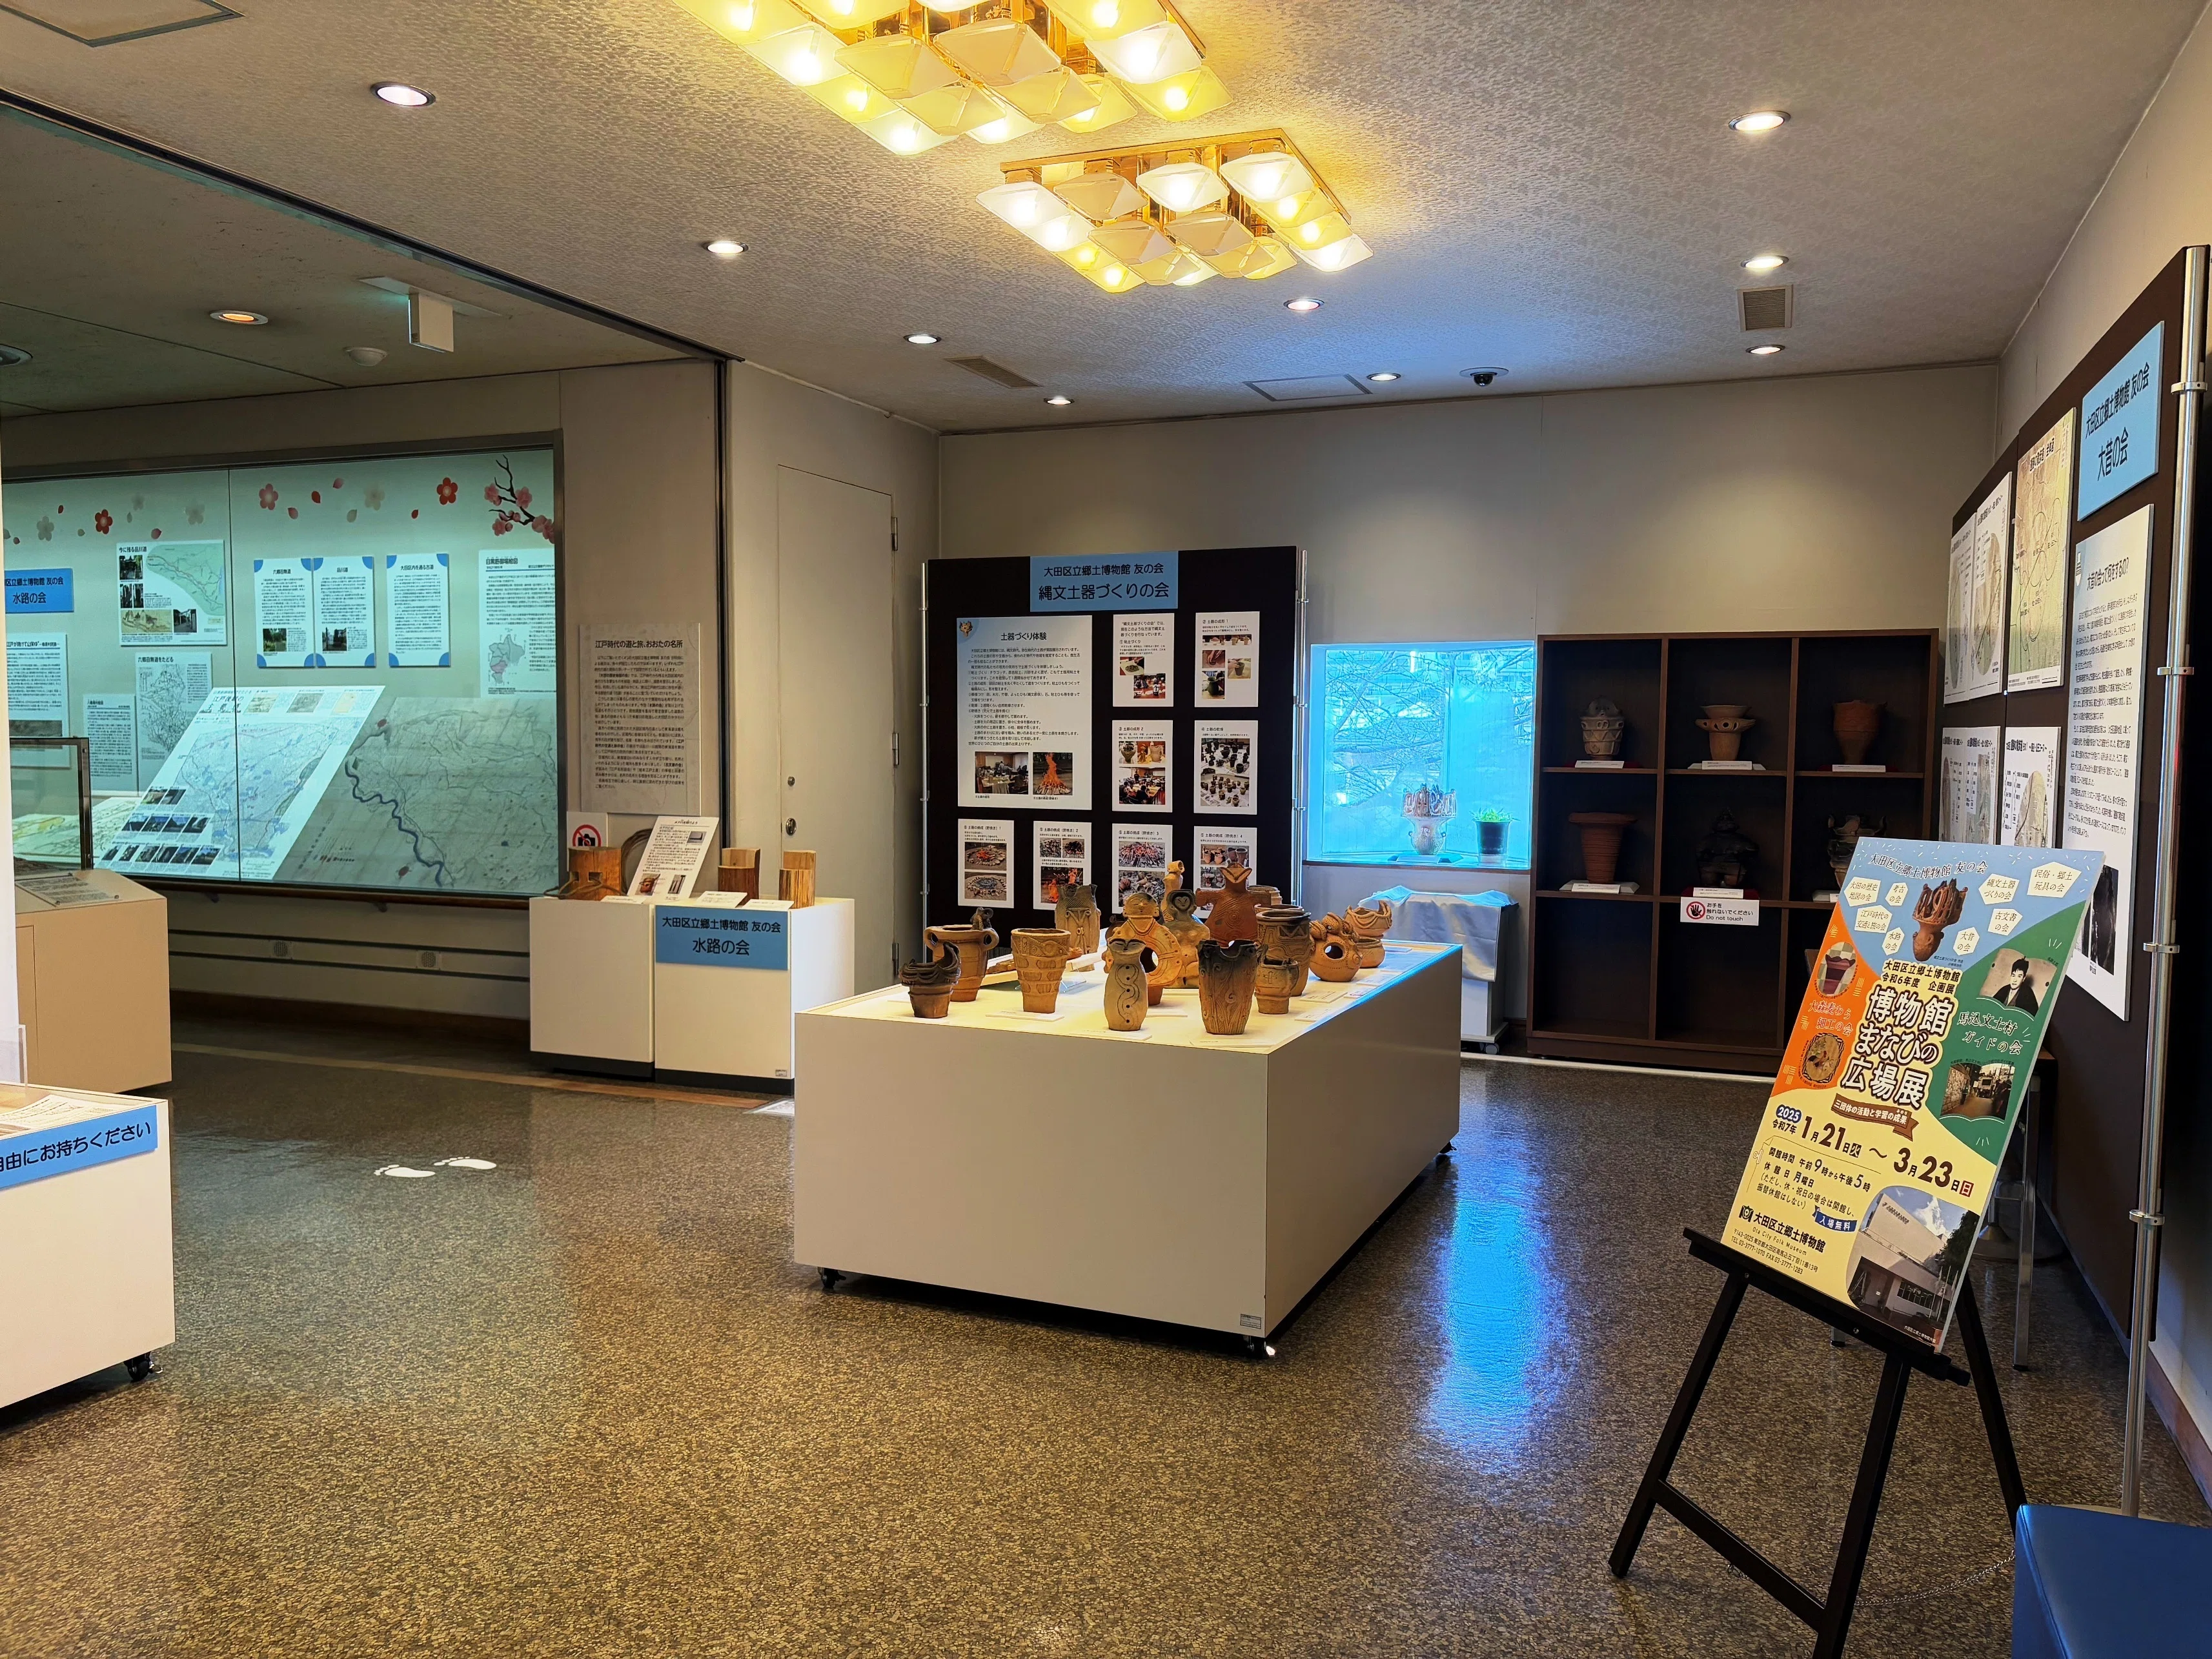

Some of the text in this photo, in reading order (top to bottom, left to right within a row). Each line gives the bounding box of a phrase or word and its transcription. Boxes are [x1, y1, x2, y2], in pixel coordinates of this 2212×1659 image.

[2085, 361, 2150, 439] 大田区立郷土博物館 友の会
[2098, 427, 2128, 481] 大昔の会
[1044, 562, 1164, 577] 大田区立郷土博物館 友の会
[5, 576, 64, 586] 区立郷土博物館 友の会
[13, 591, 46, 604] 水路の会
[1039, 582, 1169, 601] 縄文土器づくりの会
[595, 640, 683, 648] 江戸時代の道と旅、おおたの名所
[1001, 632, 1047, 641] 土器づくり体験
[1870, 853, 1987, 879] 大田区立郷土博物館 友の会
[2034, 869, 2073, 881] 民俗・郷土
[1850, 880, 1878, 892] 大田の歴史
[1892, 884, 1905, 894] 考古
[1986, 879, 2017, 889] 縄文土器
[2034, 880, 2065, 893] 玩具の会
[1849, 891, 1872, 902] 地図の会
[1889, 894, 1902, 904] の会
[1984, 889, 2012, 901] づくりの会
[1860, 910, 1889, 921] 江戸時代の
[1994, 911, 2017, 922] 古文書
[662, 916, 781, 933] 大田区立郷土博物館 友の会
[1855, 919, 1887, 931] 交通と旅の会
[1994, 922, 2010, 933] の会
[1888, 931, 1901, 941] 水路
[1961, 931, 1975, 941] 大昔
[693, 937, 750, 955] 水路の会
[1884, 941, 1898, 952] の会
[1957, 941, 1972, 953] の会
[1883, 960, 1961, 982] 大田区立郷土博物館
[1882, 972, 1956, 995] 令和6年度 企画展
[1807, 999, 1852, 1021] 大森麦わら
[1865, 986, 1954, 1038] 博物館
[1815, 1017, 1854, 1037] 細工の会
[1956, 1011, 2018, 1037] 馬込文士村
[1854, 1021, 1938, 1066] まなびの
[1962, 1030, 2024, 1056] ガイドの会
[1840, 1055, 1930, 1110] 広場展
[1778, 1106, 1800, 1122] 2025
[1833, 1099, 1907, 1125] 三団体の活動と学習の成果
[1772, 1119, 1798, 1135] 令和7年
[1769, 1146, 1871, 1193] 開館時間 午前9時から午後5時
[1793, 1171, 1814, 1188] 月曜日
[1756, 1183, 1807, 1210] 振替休館はしない）
[1819, 1216, 1851, 1232] 入場無料
[1733, 1228, 1754, 1243] 〒143-0025
[1753, 1212, 1826, 1254] 大田区立郷土博物館
[1762, 1231, 1772, 1241] City
[1773, 1236, 1784, 1246] Folk
[1785, 1241, 1807, 1256] Museum
[1738, 1239, 1766, 1257] 03-3777-1070
[1765, 1252, 1774, 1261] FAX
[1774, 1257, 1803, 1275] 03-3777-1283
